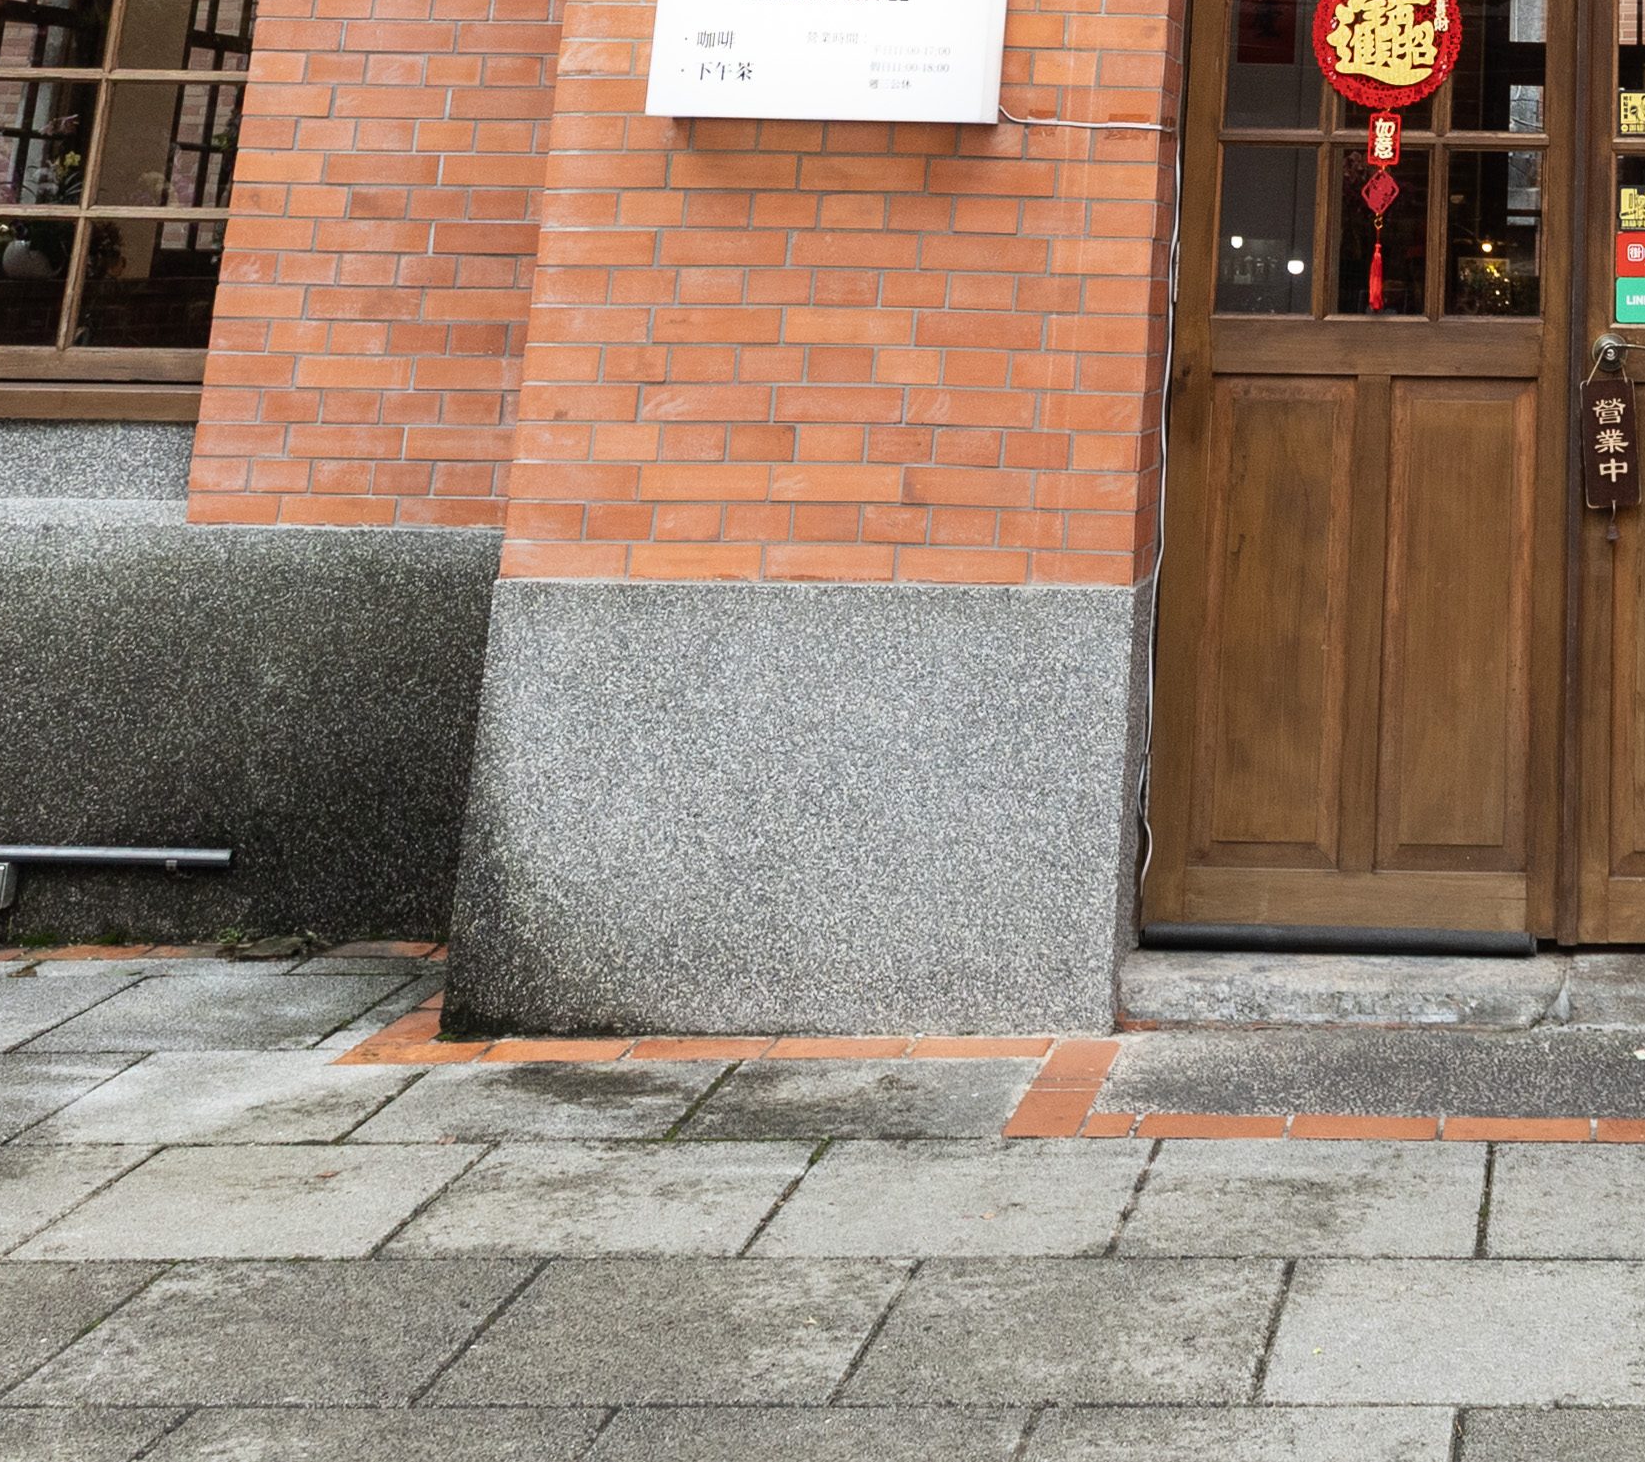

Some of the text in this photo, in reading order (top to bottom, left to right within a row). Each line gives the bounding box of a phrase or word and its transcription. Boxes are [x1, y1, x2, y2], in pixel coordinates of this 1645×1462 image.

[697, 30, 735, 49] 咖啡
[697, 62, 755, 81] 下午茶
[1592, 397, 1630, 484] 營業中
